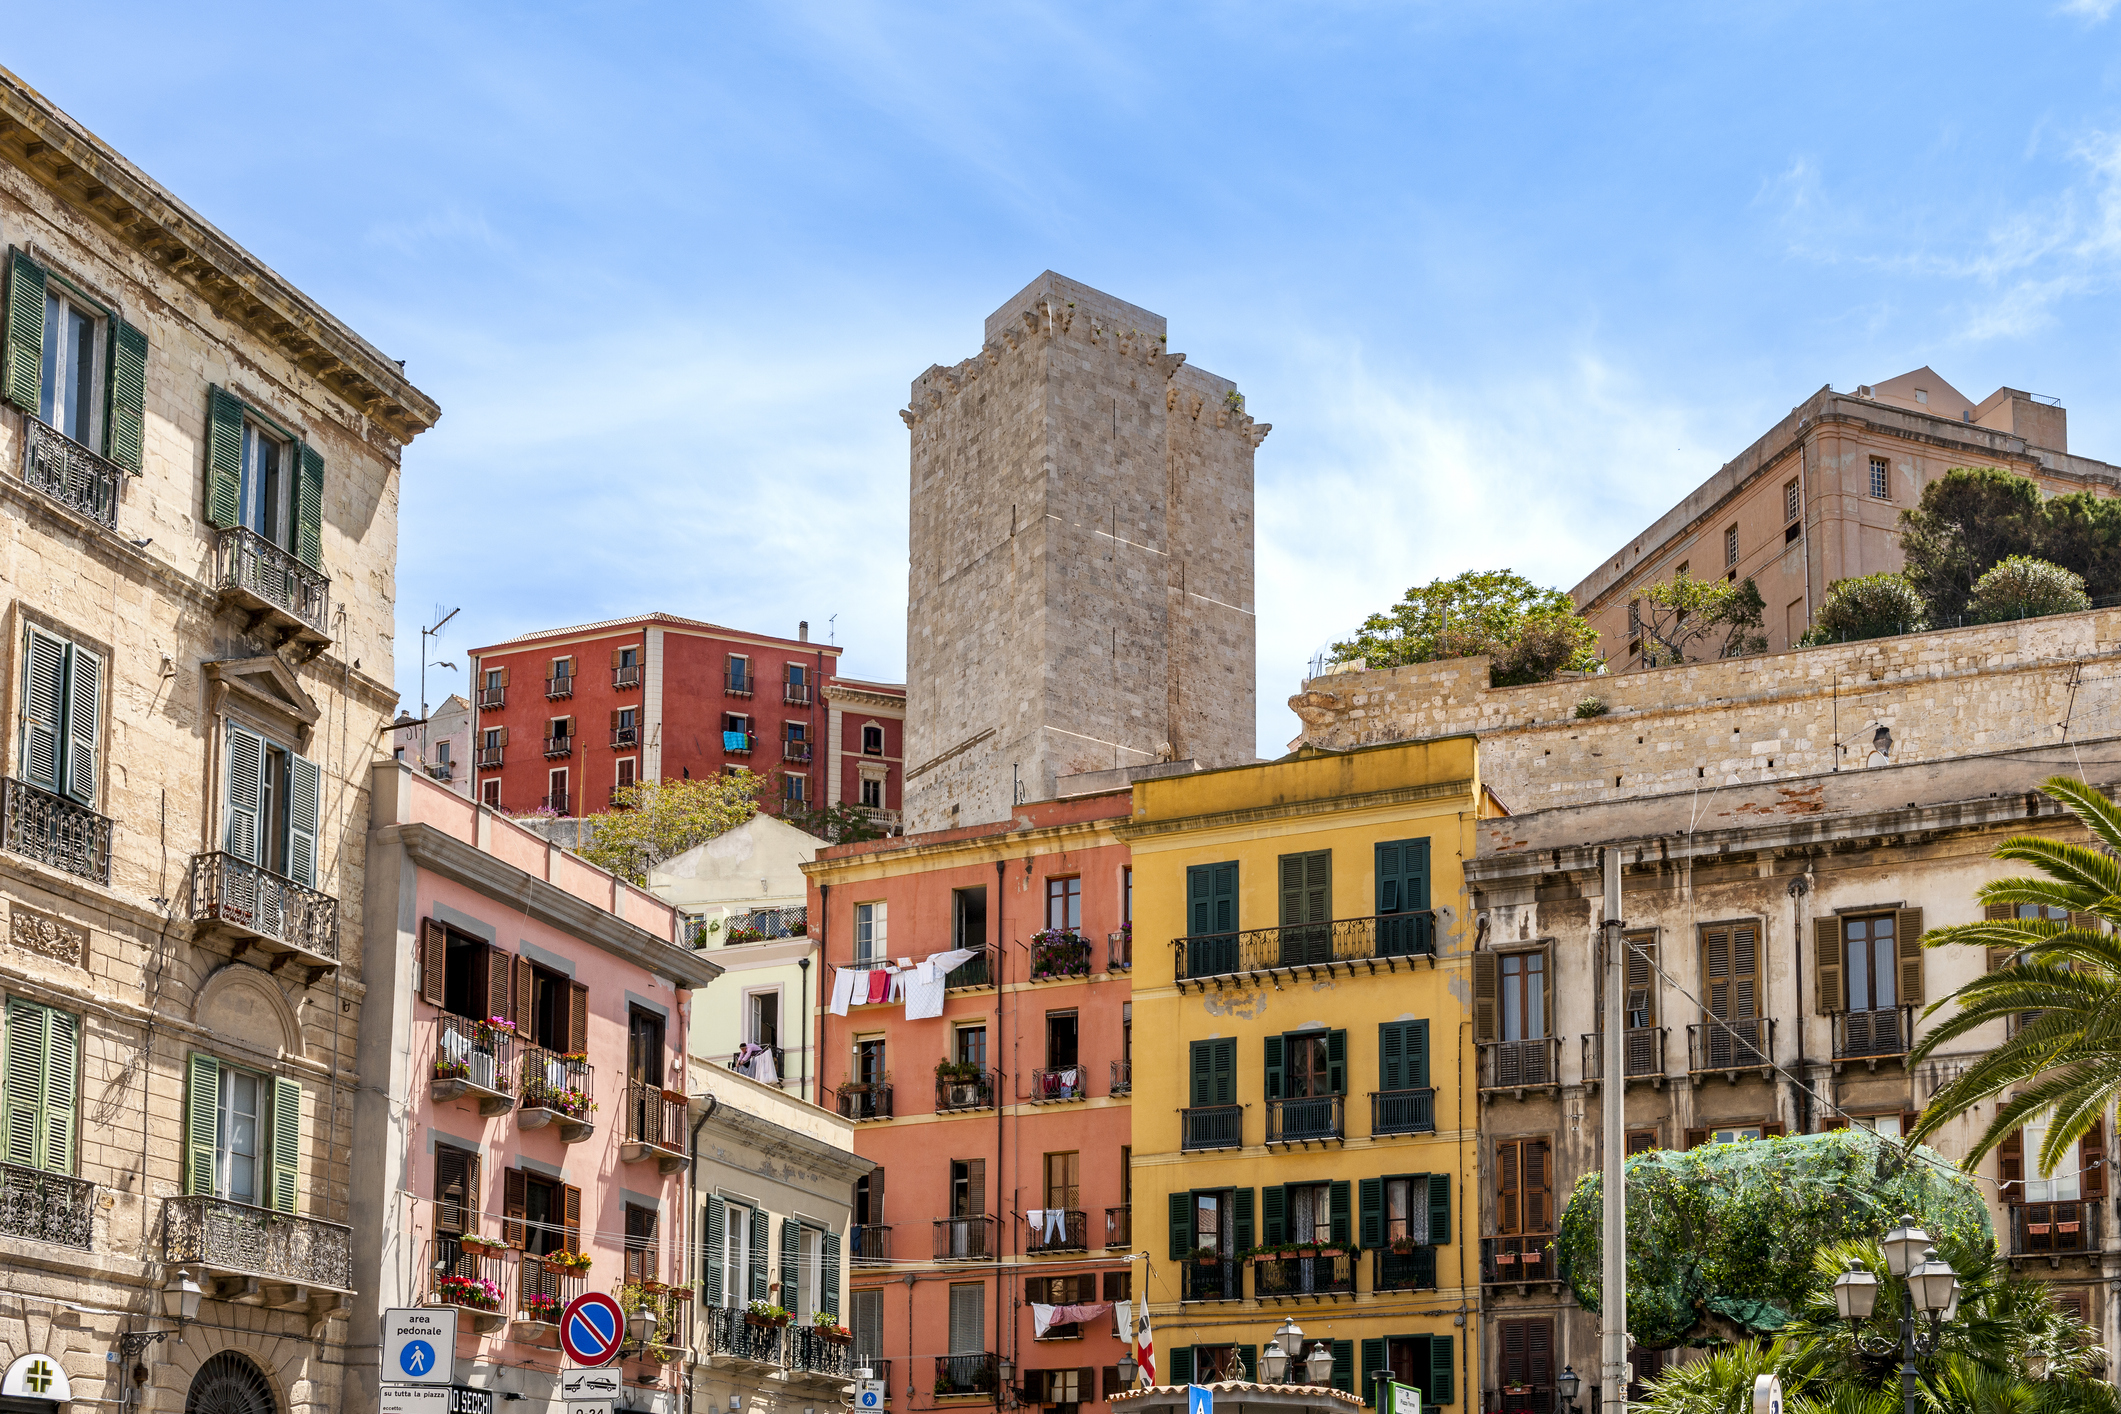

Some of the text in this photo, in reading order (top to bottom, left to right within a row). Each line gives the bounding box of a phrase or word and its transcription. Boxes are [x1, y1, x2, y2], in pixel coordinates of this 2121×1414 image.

[409, 1316, 430, 1324] area
[397, 1326, 442, 1336] pedonale
[461, 1391, 491, 1414] SECCHI
